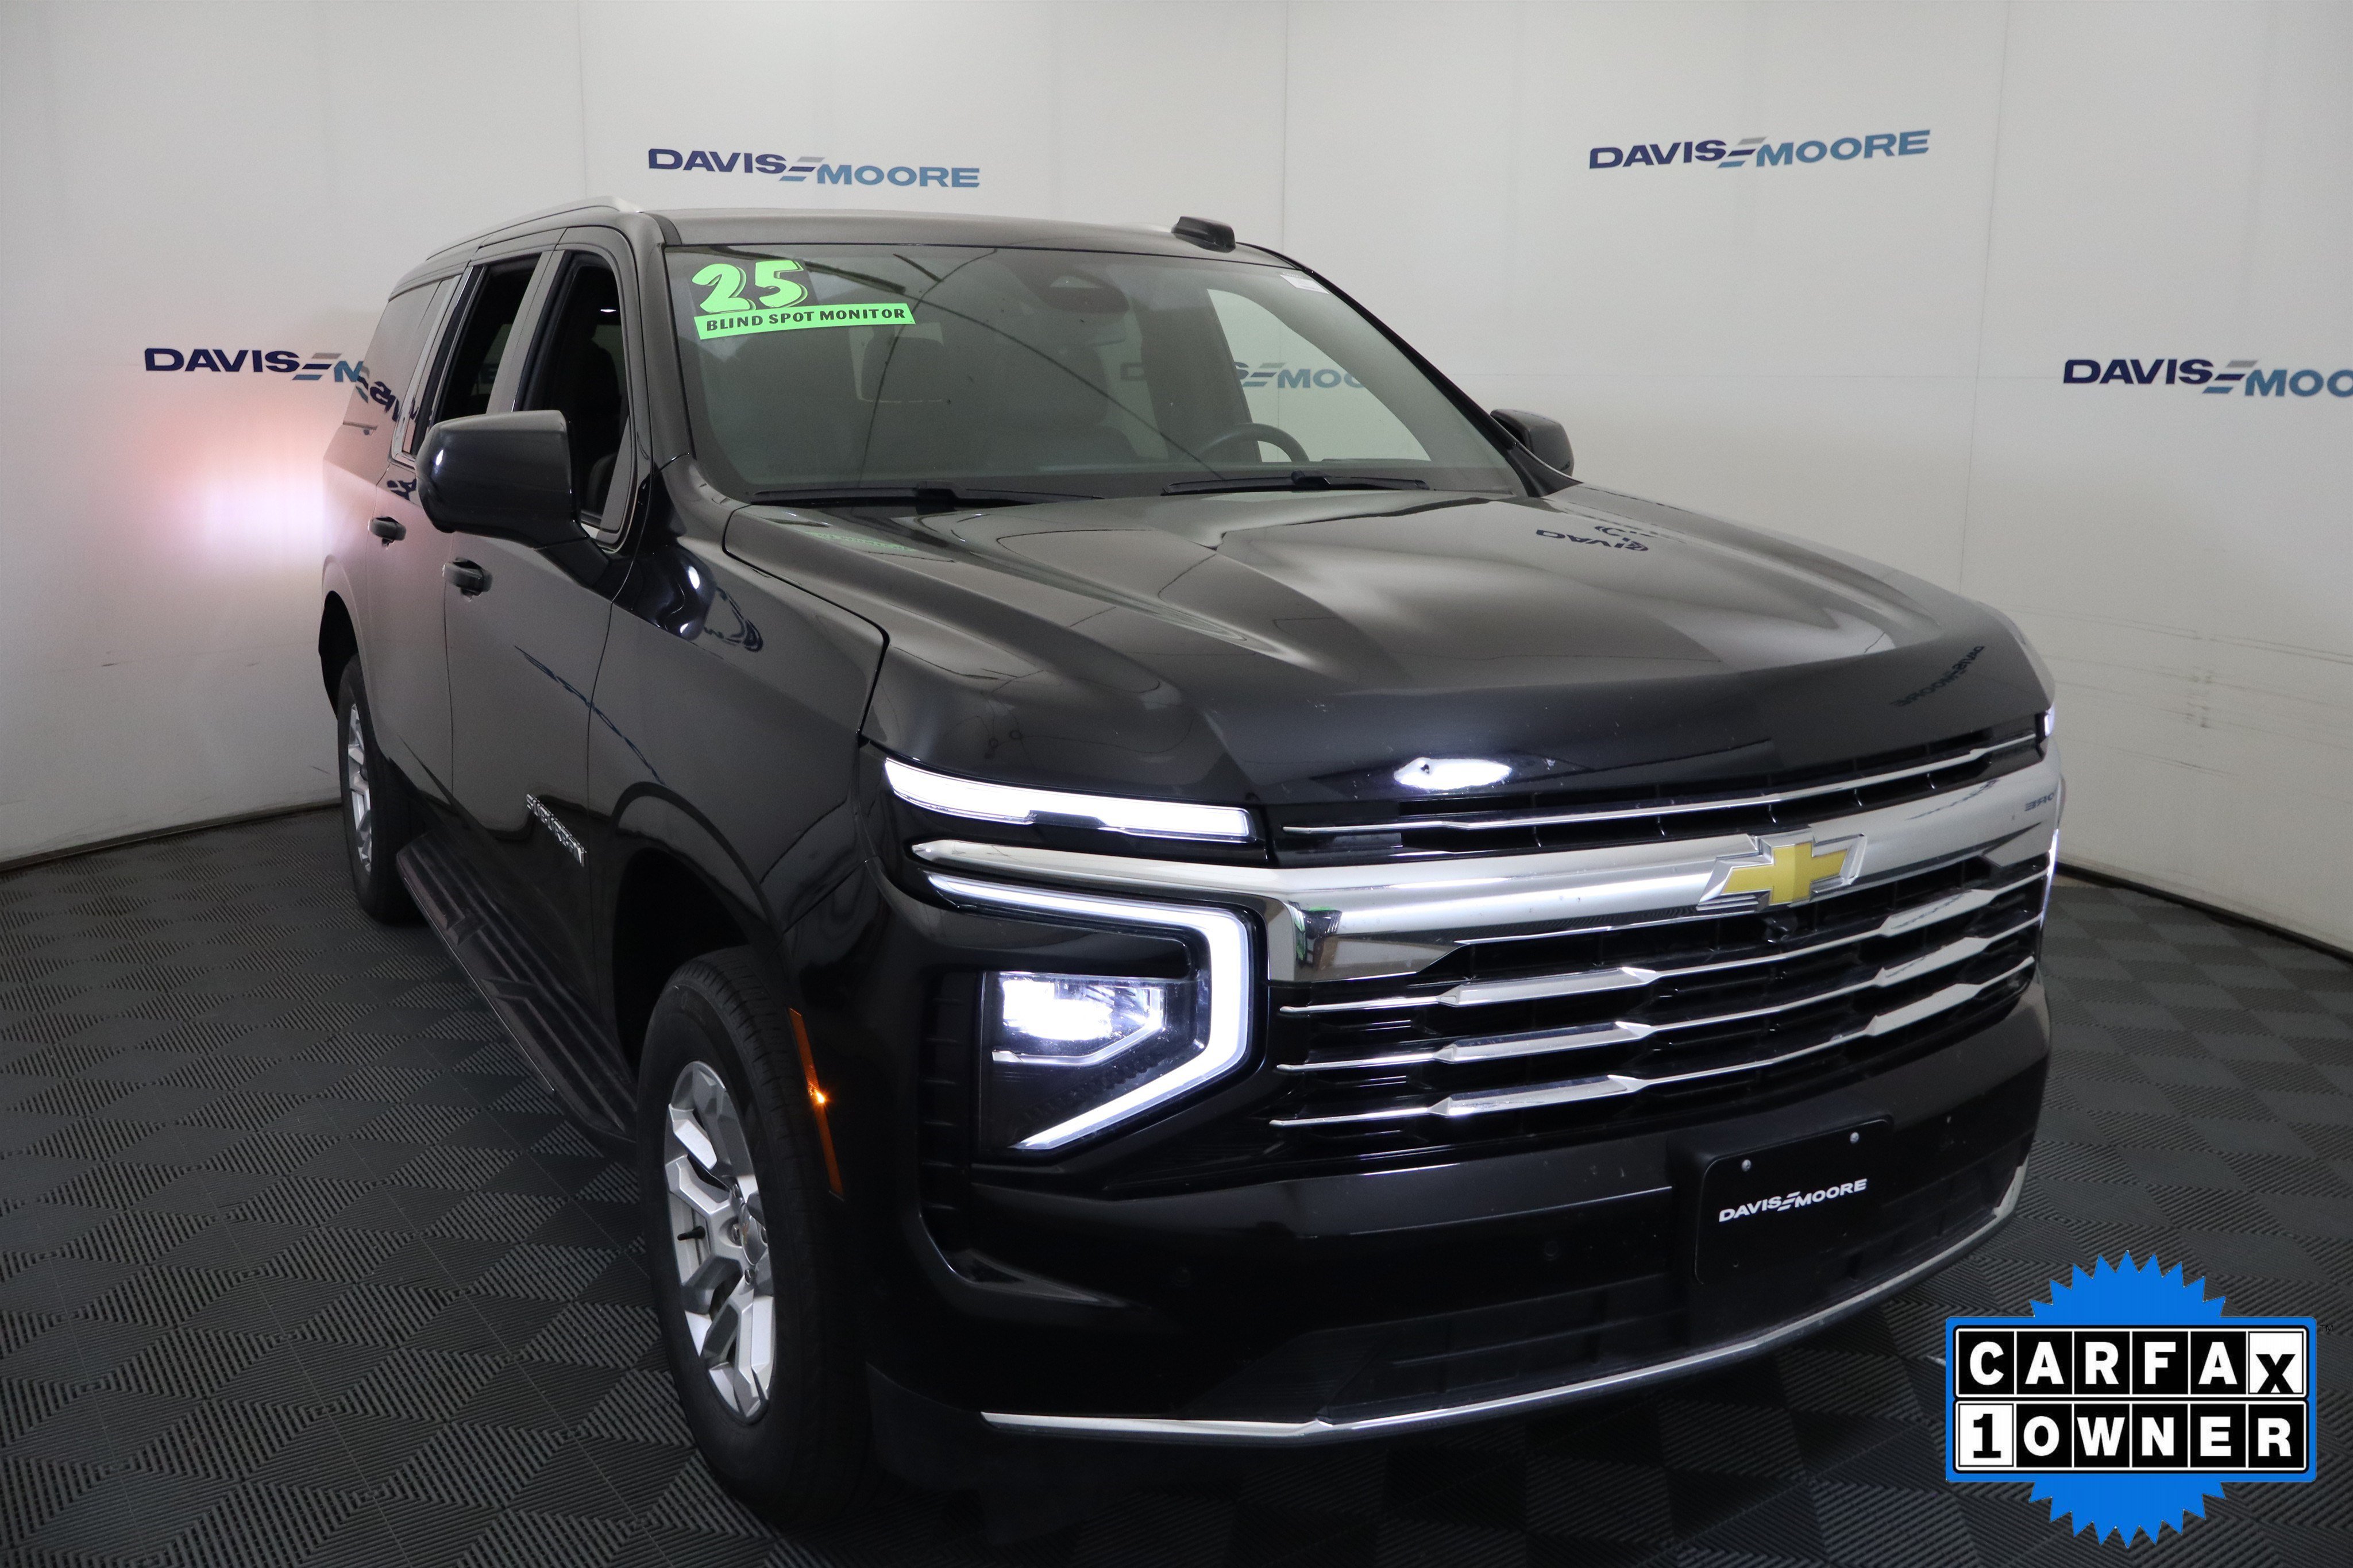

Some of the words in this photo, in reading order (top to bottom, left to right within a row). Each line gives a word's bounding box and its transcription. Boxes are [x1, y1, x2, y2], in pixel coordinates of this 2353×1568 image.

[647, 148, 787, 174] DAVIS
[817, 164, 980, 188] MOORE
[1589, 140, 1726, 169] DAVIS
[1756, 129, 1931, 167] MOORE
[692, 260, 808, 314] 25
[705, 314, 763, 332] BLIND
[768, 311, 815, 325] SPOT
[819, 308, 905, 320] MONITOR
[144, 347, 300, 373] DAVIS
[2063, 359, 2215, 385] DAVIS
[1718, 1195, 1783, 1222] DAVIS
[1794, 1178, 1868, 1208] MOORE
